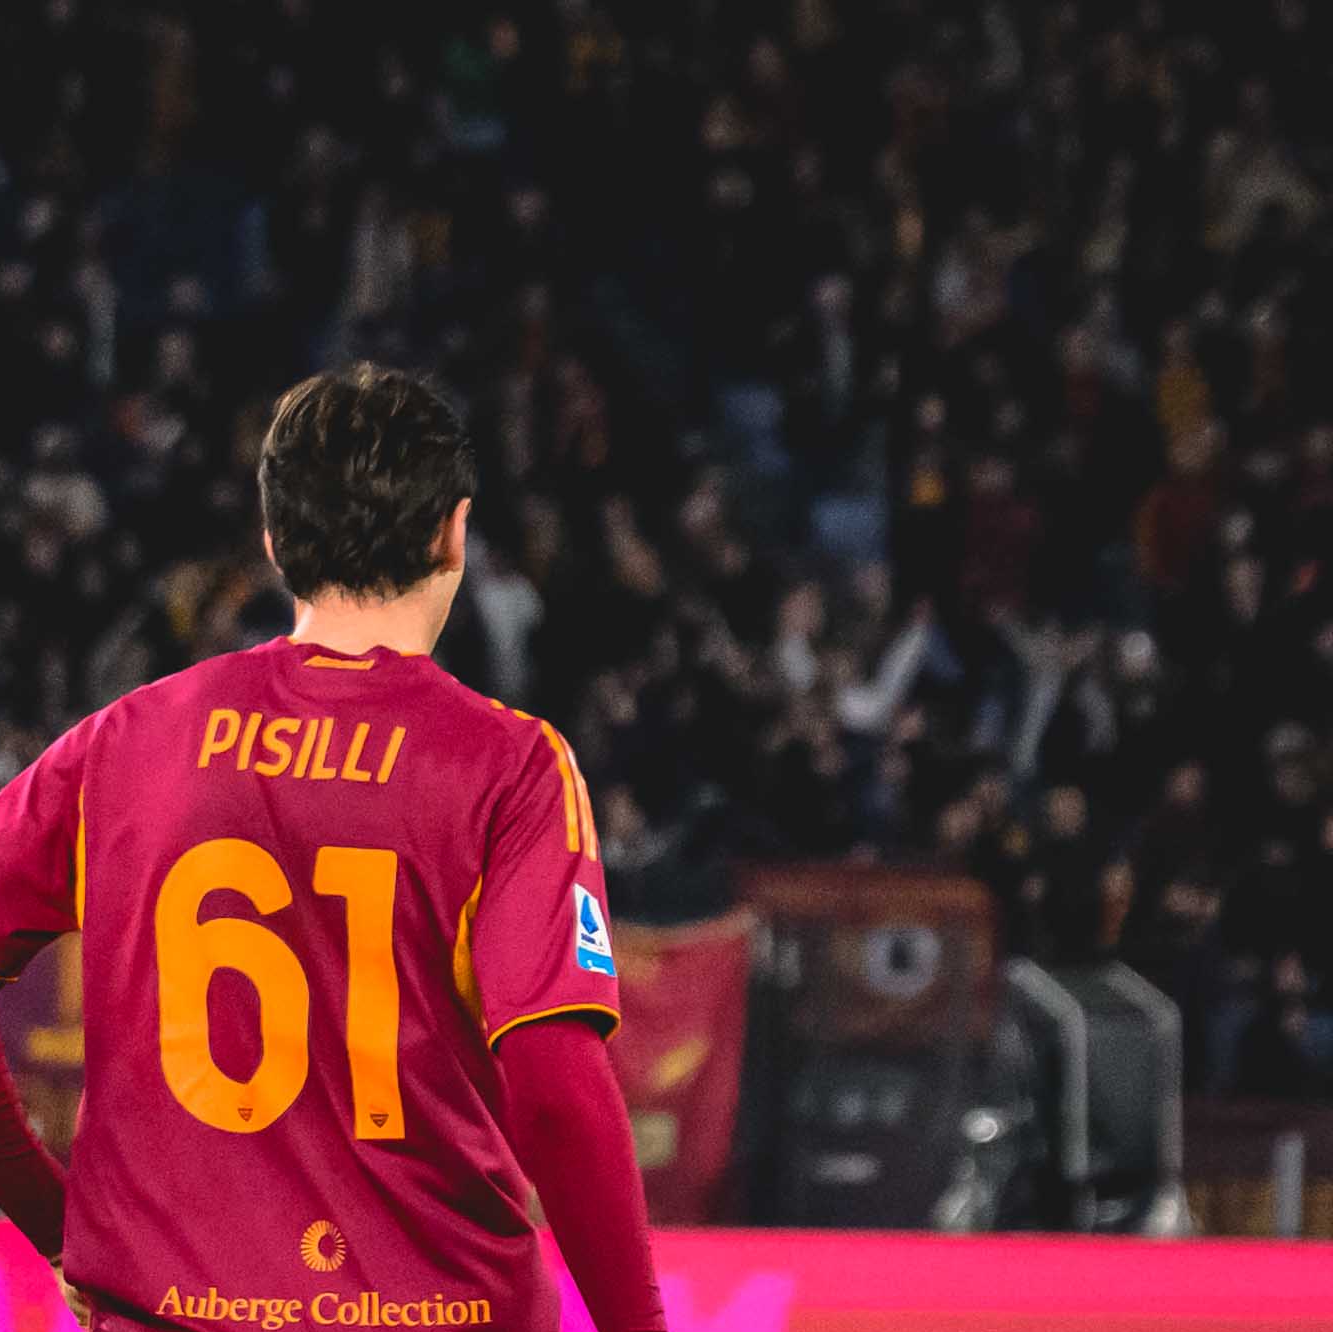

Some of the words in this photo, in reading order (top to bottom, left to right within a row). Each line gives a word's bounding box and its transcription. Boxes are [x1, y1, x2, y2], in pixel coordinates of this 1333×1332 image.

[197, 708, 407, 785] PISILLI
[154, 836, 407, 1141] 61
[155, 1285, 304, 1331] Auberge
[309, 1290, 494, 1328] Collection
